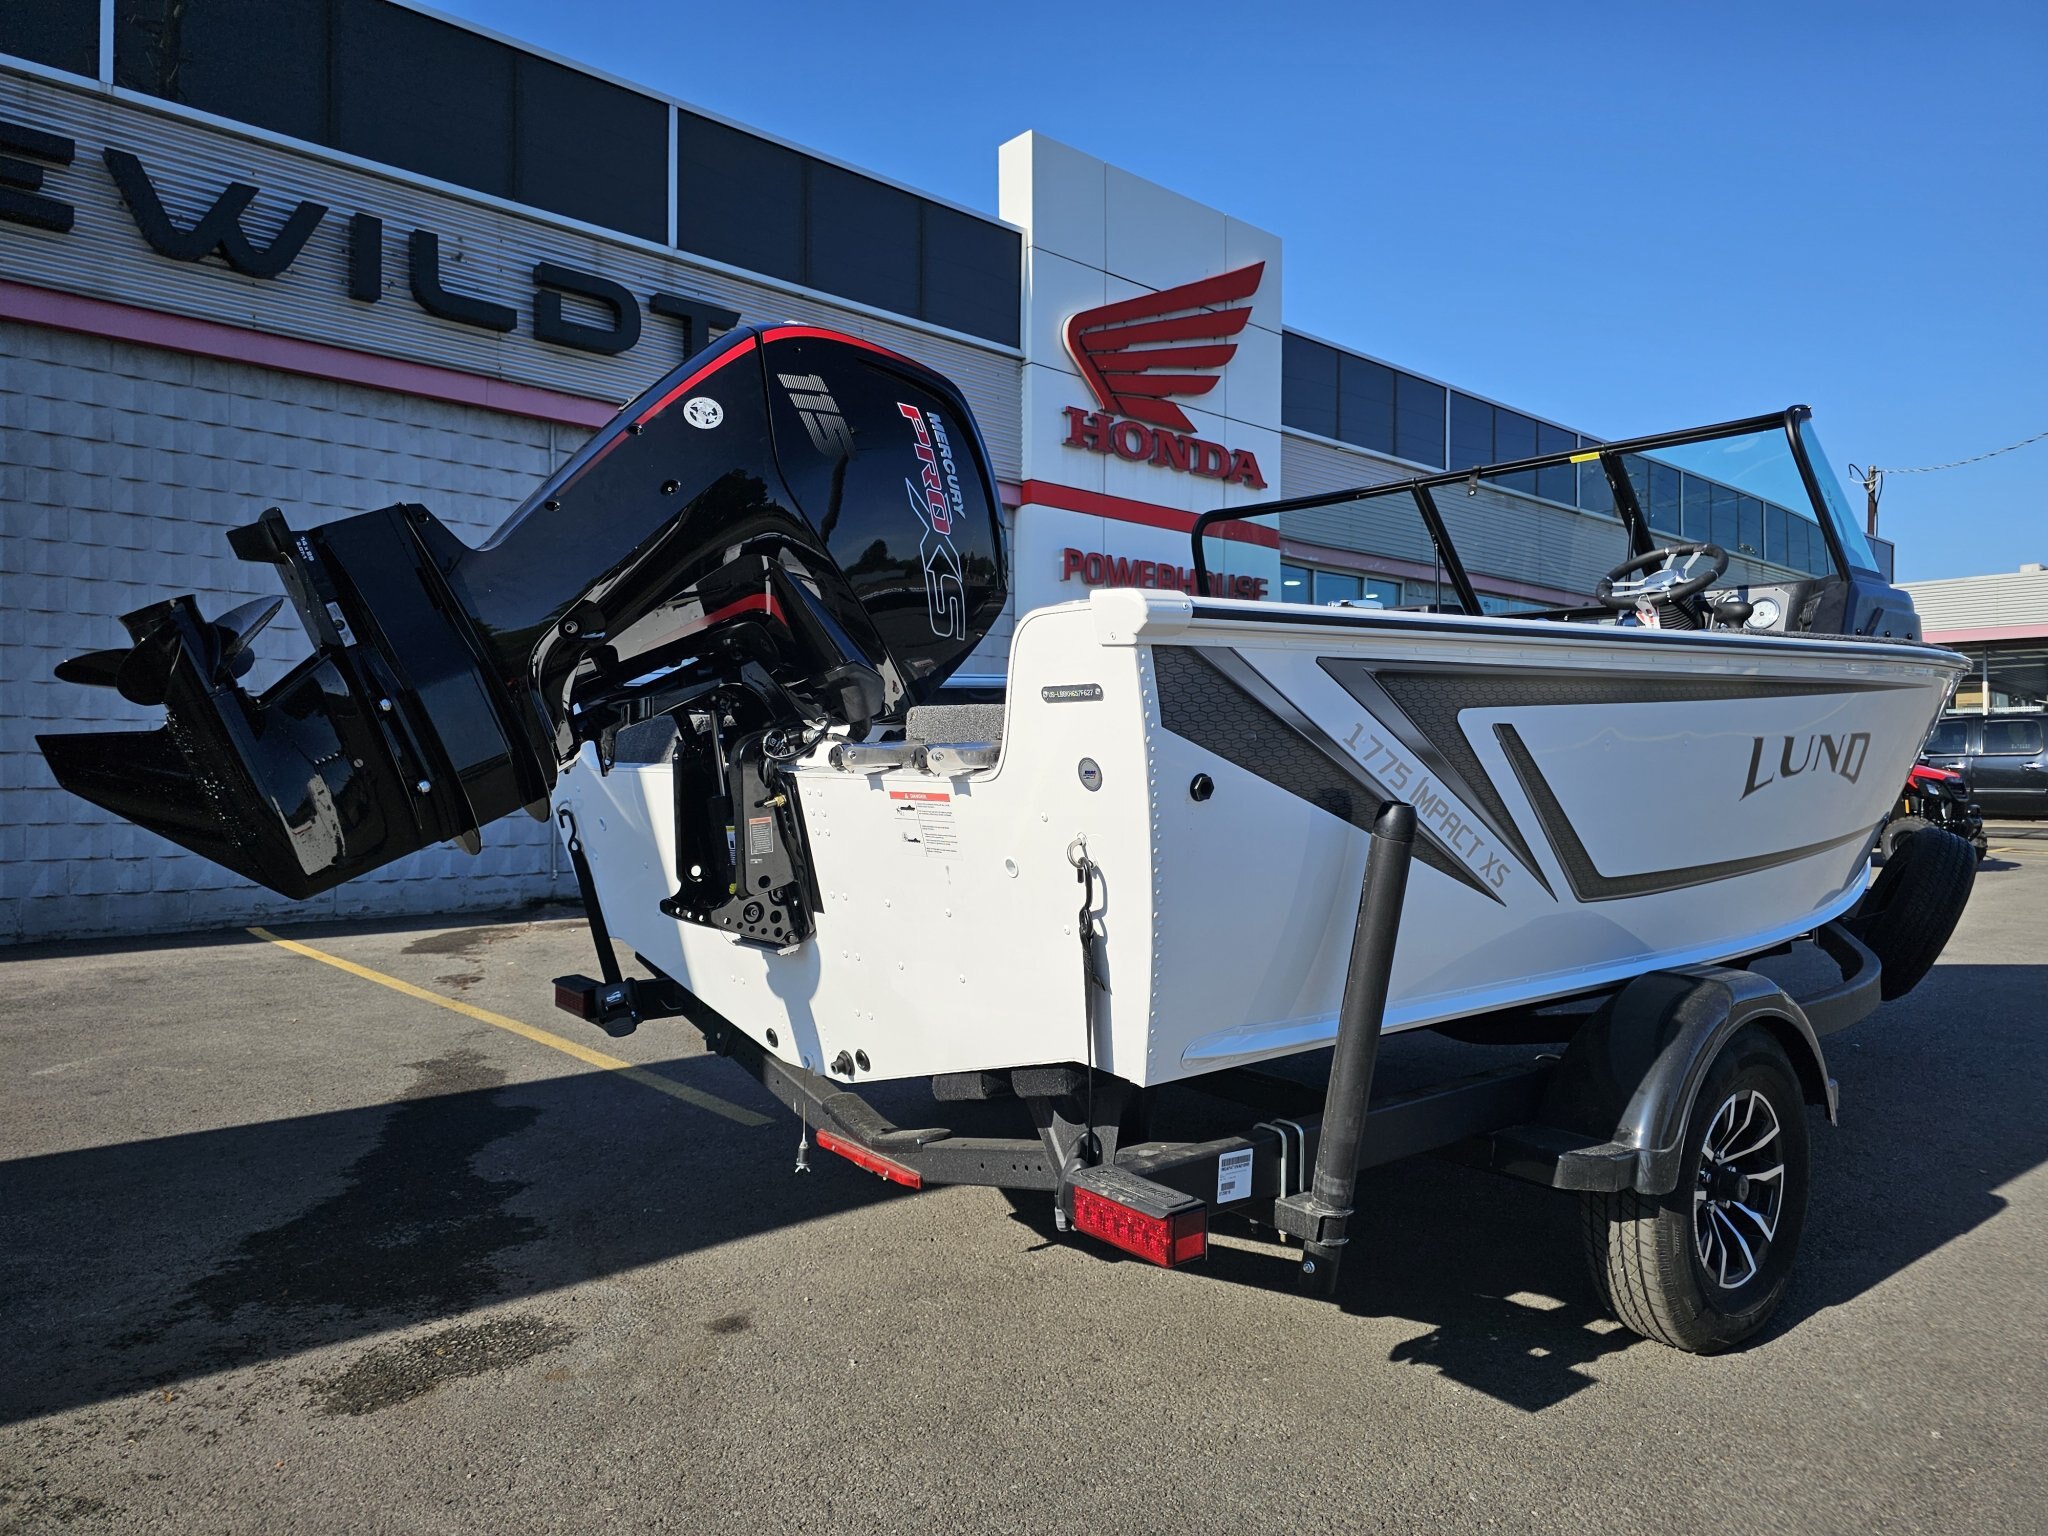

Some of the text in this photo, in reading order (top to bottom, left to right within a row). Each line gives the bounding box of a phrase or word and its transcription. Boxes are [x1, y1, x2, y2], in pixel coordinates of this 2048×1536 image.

[926, 411, 966, 519] MERCURY
[1062, 406, 1268, 489] HONDA
[897, 402, 966, 641] PRO XS
[1343, 723, 1511, 888] 1775 IMPACT XS
[1739, 732, 1871, 801] LUND
